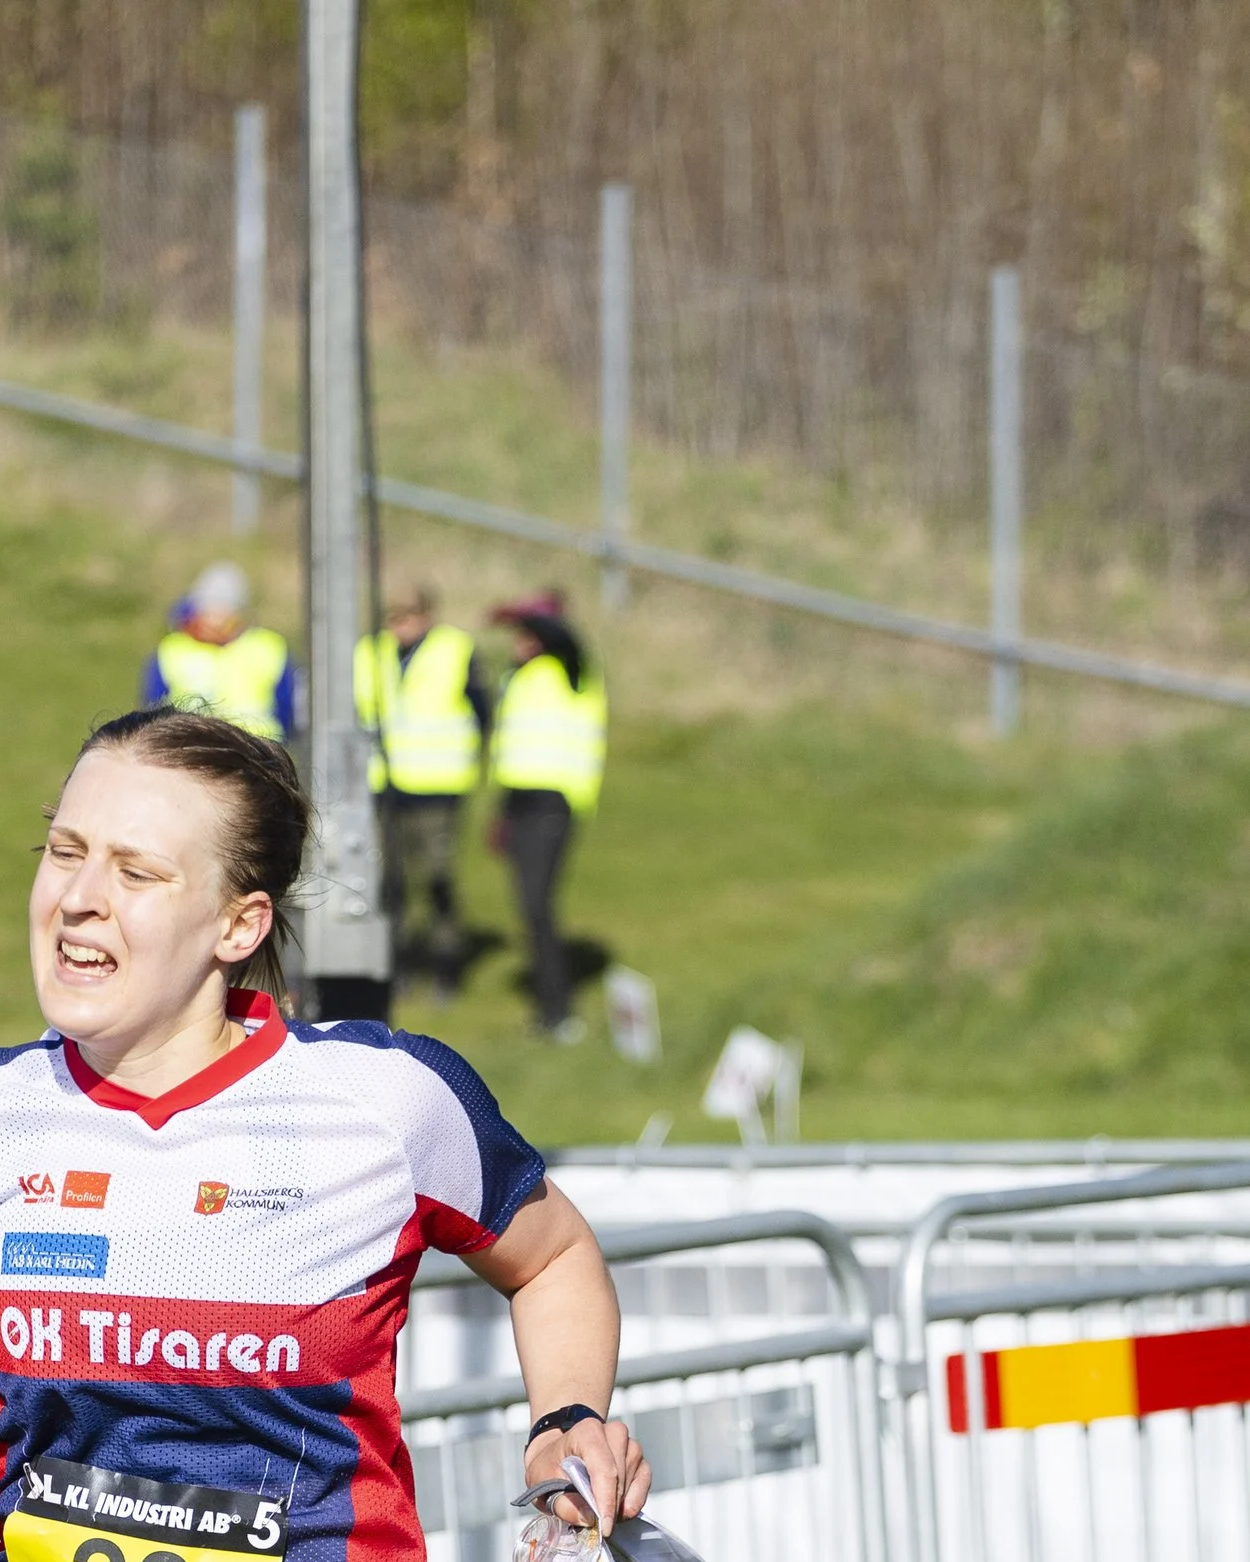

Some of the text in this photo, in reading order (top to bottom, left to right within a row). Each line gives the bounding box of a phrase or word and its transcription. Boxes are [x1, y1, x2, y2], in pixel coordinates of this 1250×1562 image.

[18, 1173, 55, 1195] ICA
[230, 1187, 304, 1198] HALLSBERGS
[225, 1199, 286, 1211] KOMMUN
[0, 1306, 300, 1373] OK Tisaren
[64, 1484, 90, 1511] KL
[94, 1492, 193, 1531] INDUSTRI
[247, 1501, 282, 1550] 5
